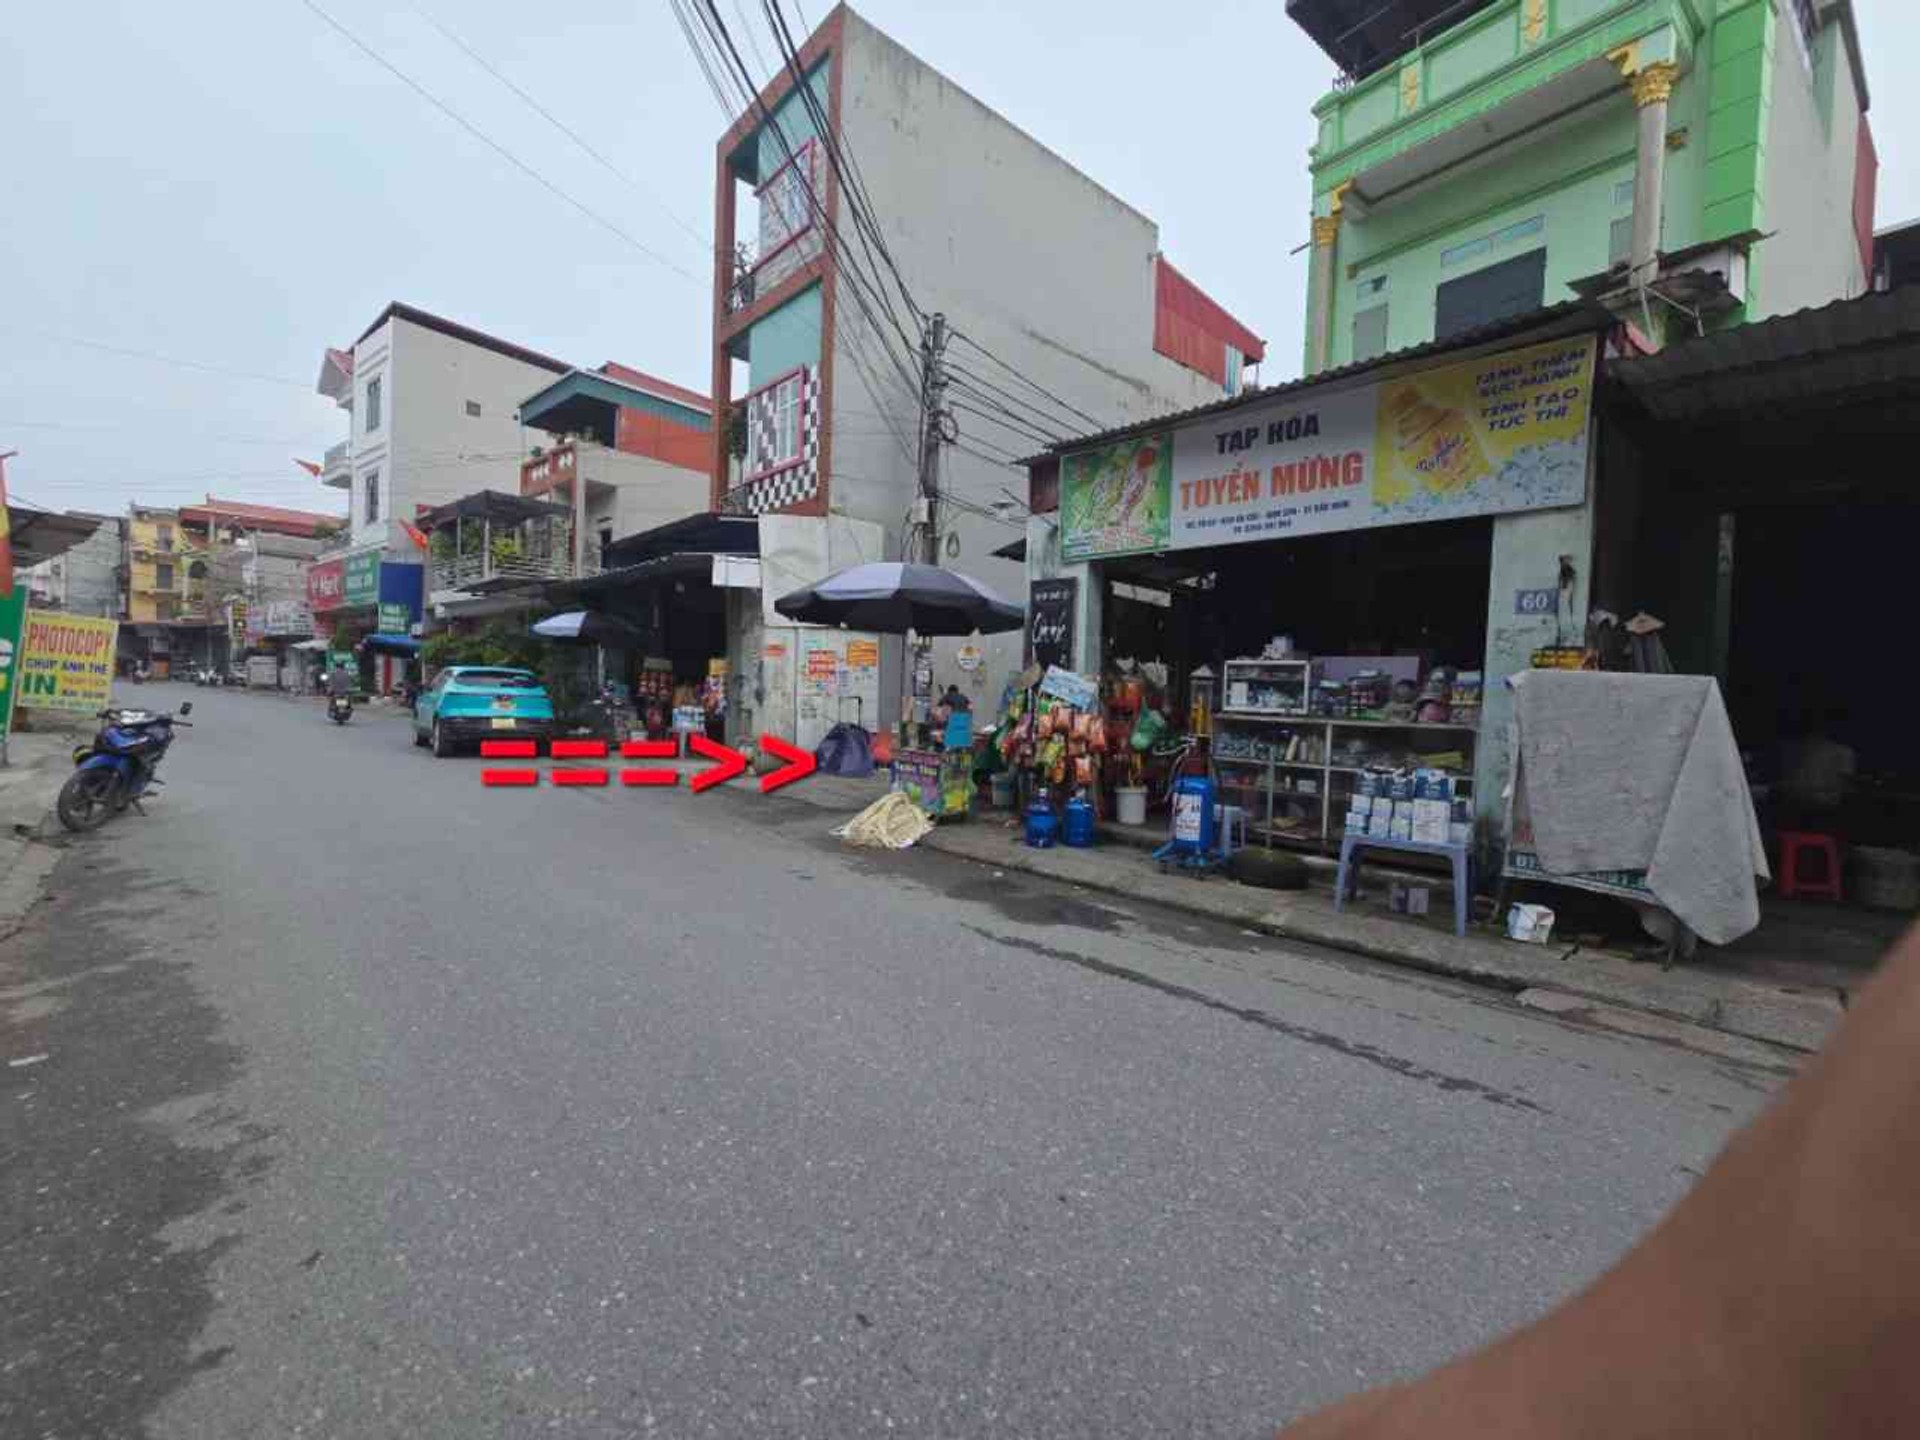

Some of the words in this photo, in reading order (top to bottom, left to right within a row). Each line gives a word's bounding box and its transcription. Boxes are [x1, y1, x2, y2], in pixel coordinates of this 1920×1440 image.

[1522, 592, 1548, 610] 60
[26, 623, 110, 657] PHOTOCOPY
[22, 672, 57, 695] IN
